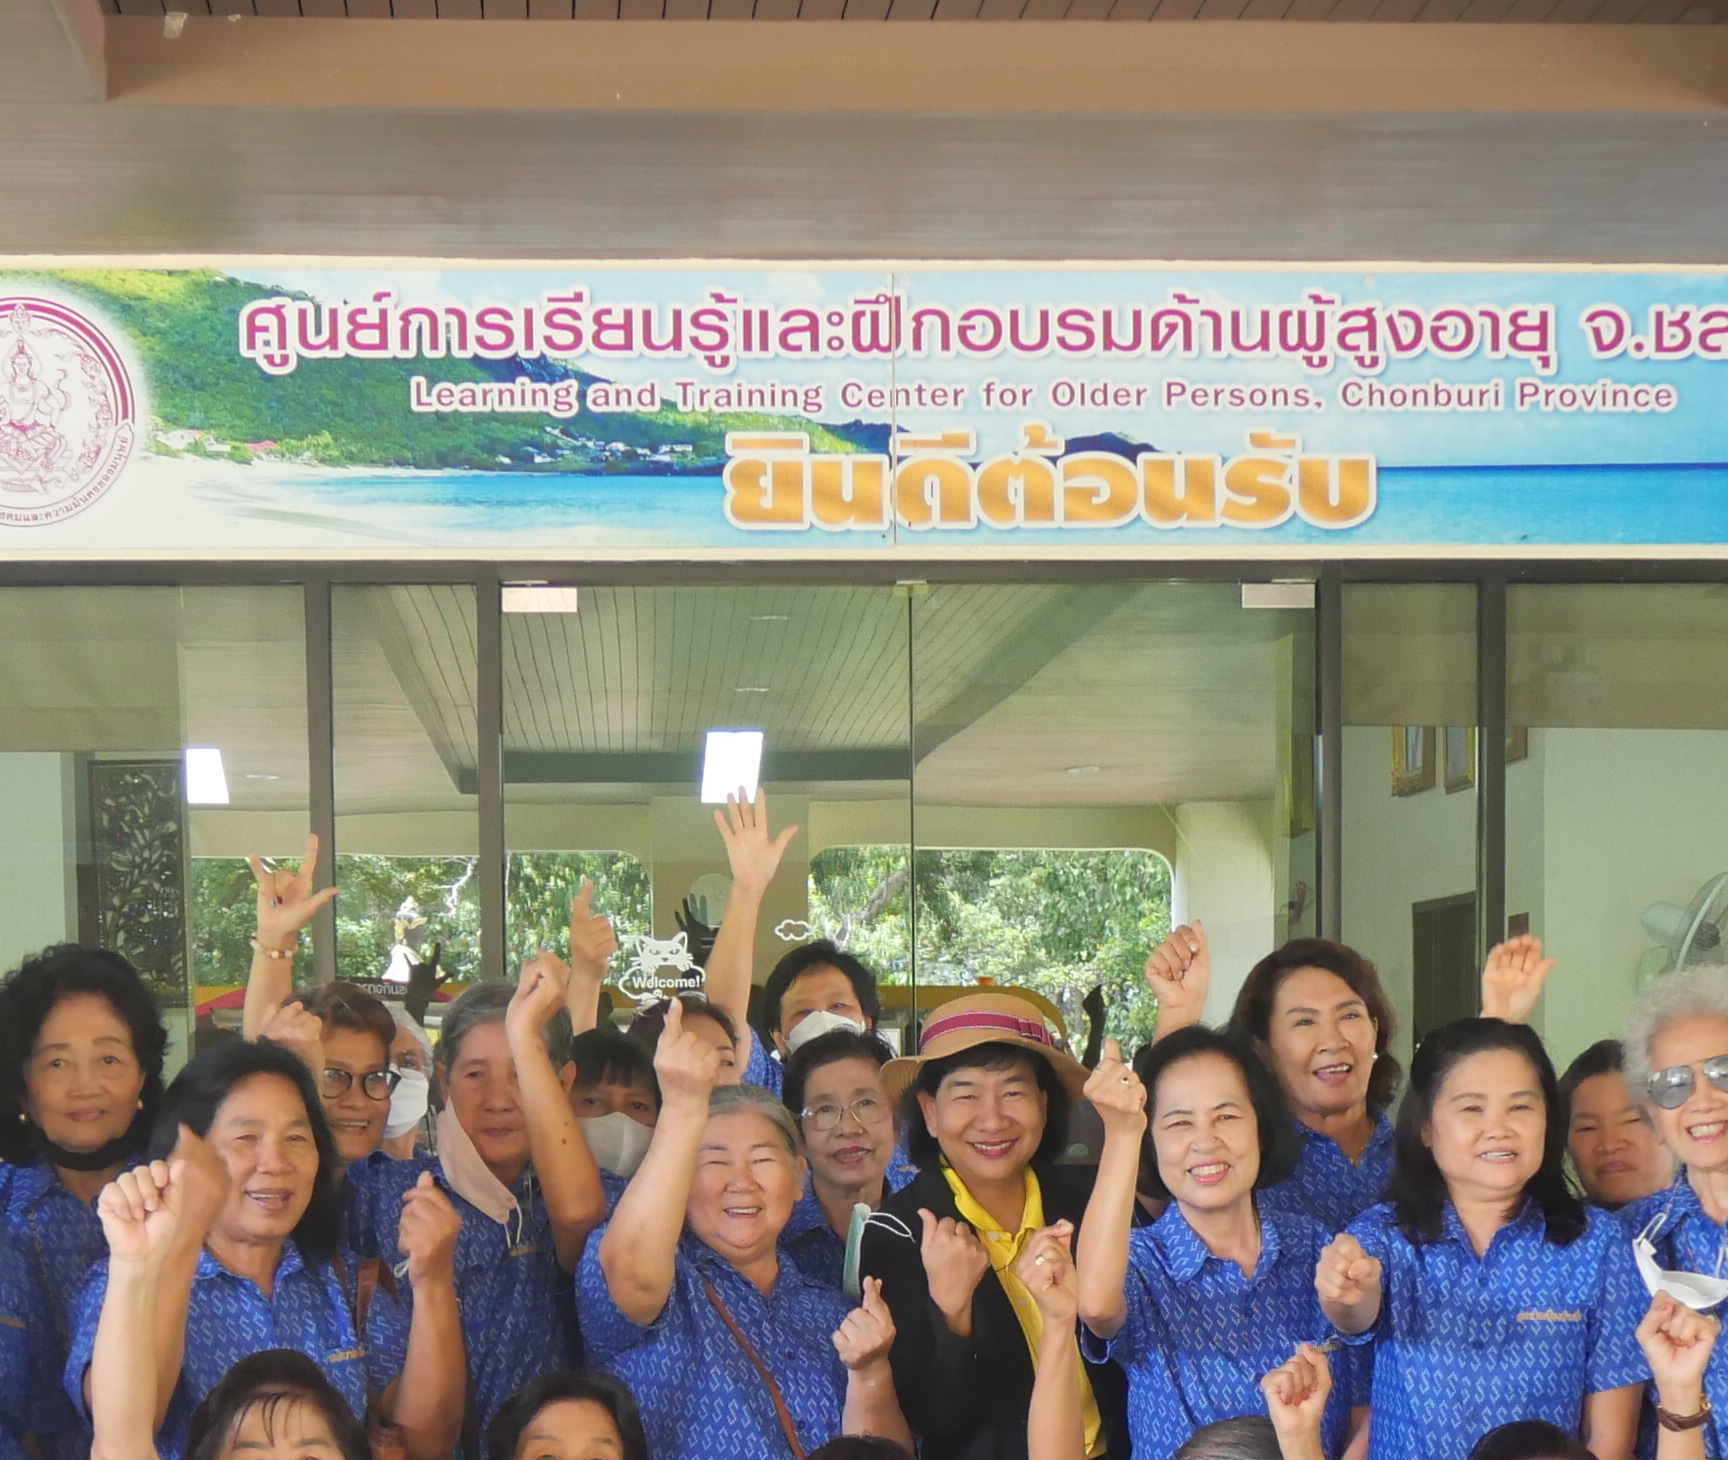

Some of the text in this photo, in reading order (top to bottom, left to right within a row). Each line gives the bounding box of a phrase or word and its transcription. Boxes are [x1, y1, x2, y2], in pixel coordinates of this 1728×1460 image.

[245, 291, 1550, 370] ศูนย์การเรียนรู้และฝึกอบรมด้านผู้สูงอายุ
[416, 380, 1672, 413] Learning and Training Center for Older Persons, Chonburi Province
[728, 423, 1372, 526] ยินดีต้อนรับ
[633, 975, 700, 988] Welcome!
